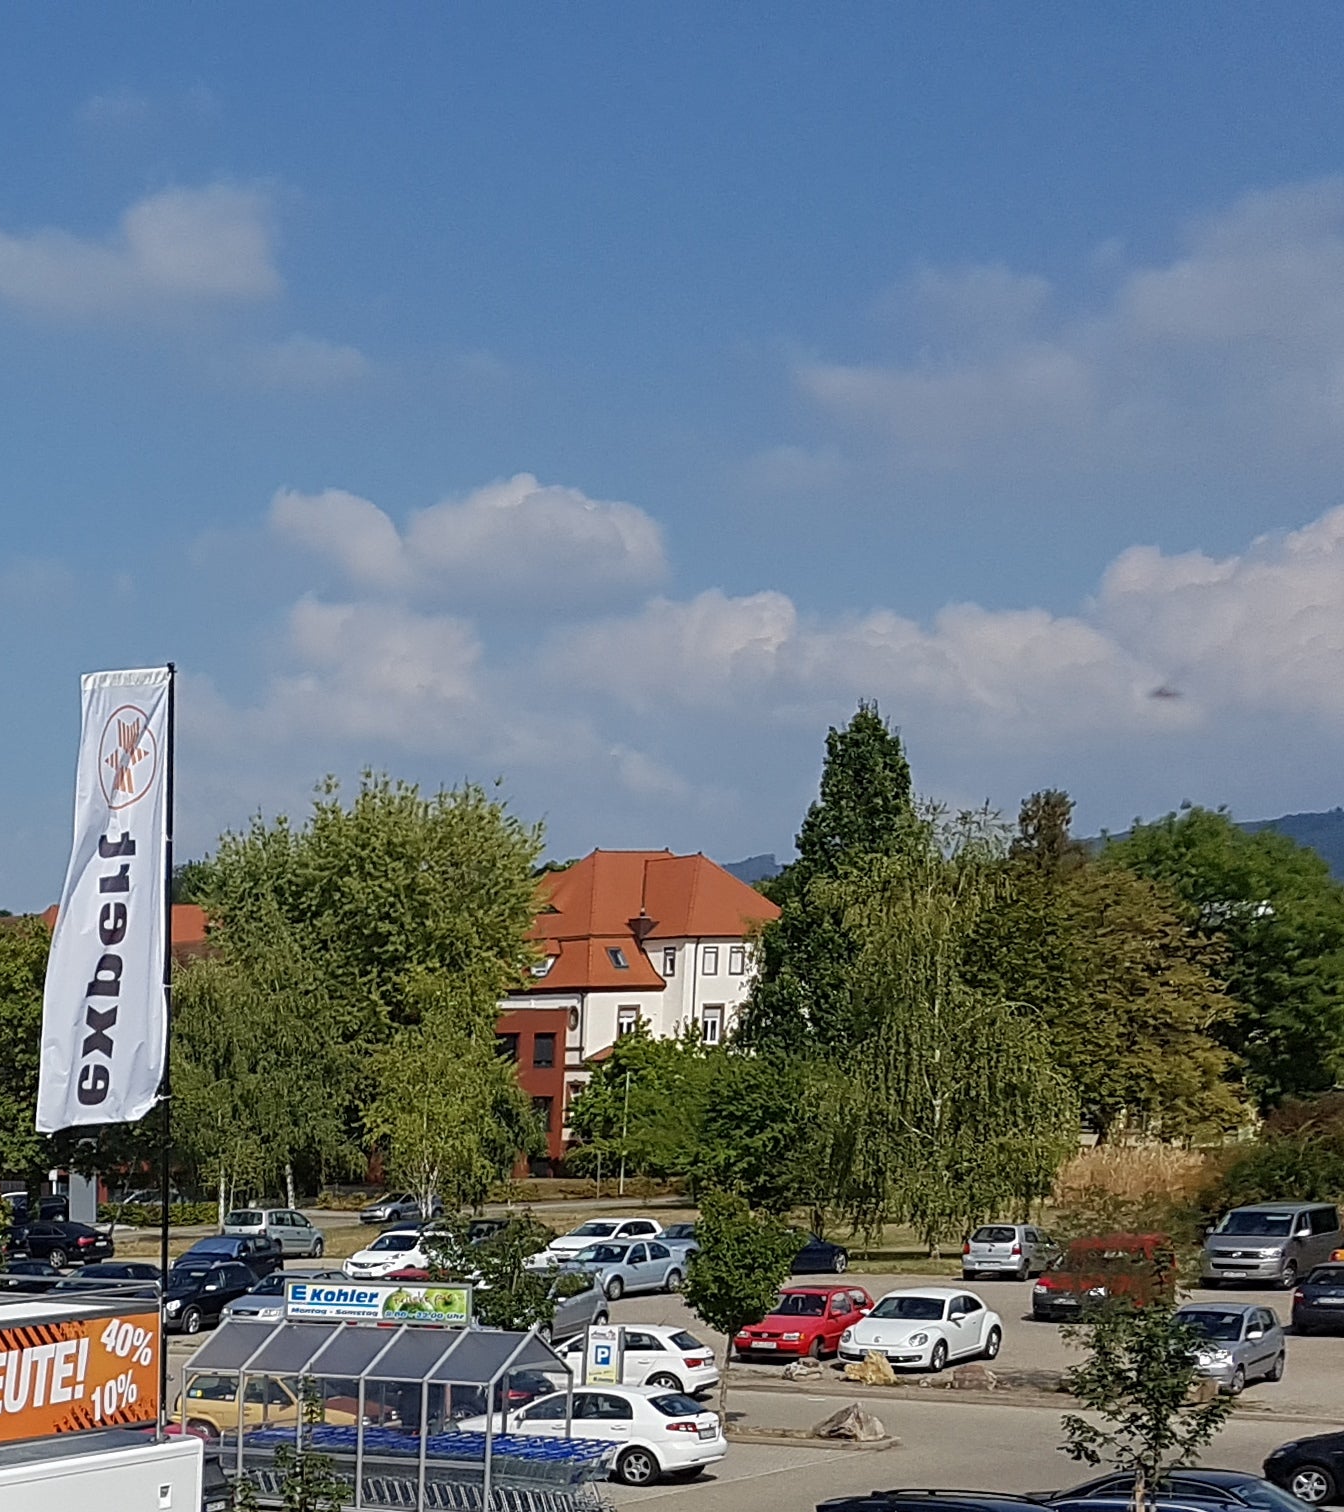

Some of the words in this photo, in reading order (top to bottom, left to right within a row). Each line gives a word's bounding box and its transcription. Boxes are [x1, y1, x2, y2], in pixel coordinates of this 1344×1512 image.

[77, 830, 136, 1106] expert
[310, 1288, 379, 1303] Kohler
[335, 1308, 379, 1317] Samstag
[100, 1317, 154, 1367] 40%
[91, 1368, 138, 1422] 10%
